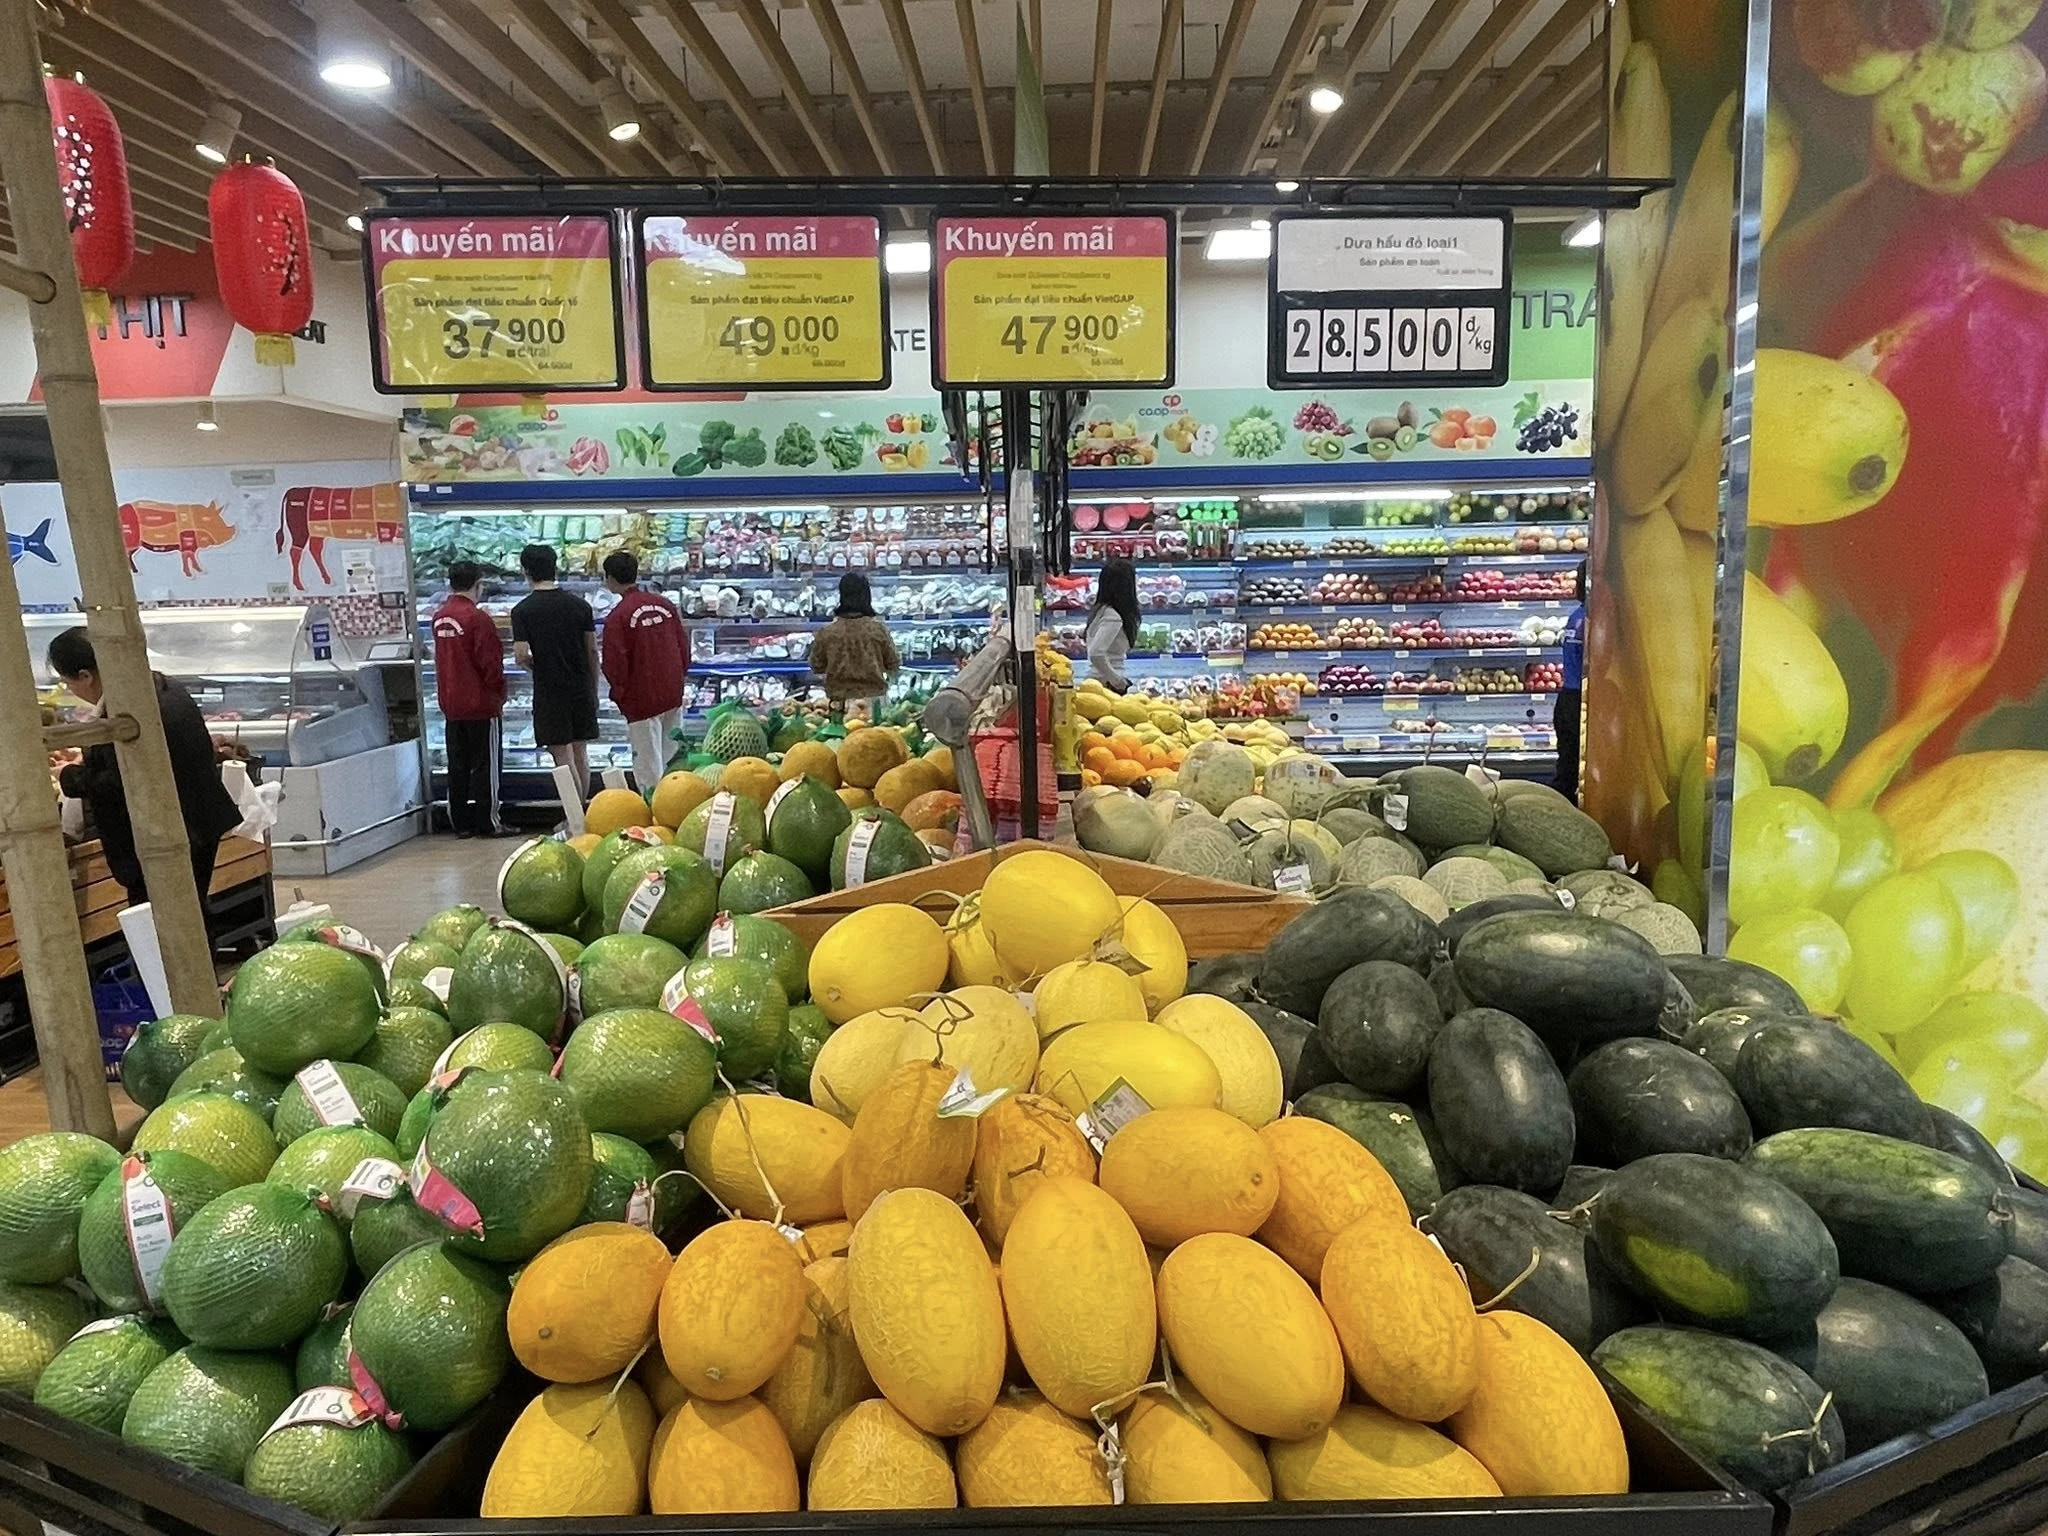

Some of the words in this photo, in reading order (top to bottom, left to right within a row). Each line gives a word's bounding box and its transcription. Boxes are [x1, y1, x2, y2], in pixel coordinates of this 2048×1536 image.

[380, 221, 492, 258] Khuyến
[501, 226, 555, 252] mãi
[765, 226, 817, 251] mãi
[945, 221, 1054, 257] Khuyến
[1063, 225, 1114, 250] mãi
[1344, 236, 1372, 249] Dưa
[1376, 234, 1401, 249] hấu
[1405, 235, 1423, 249] đỏ
